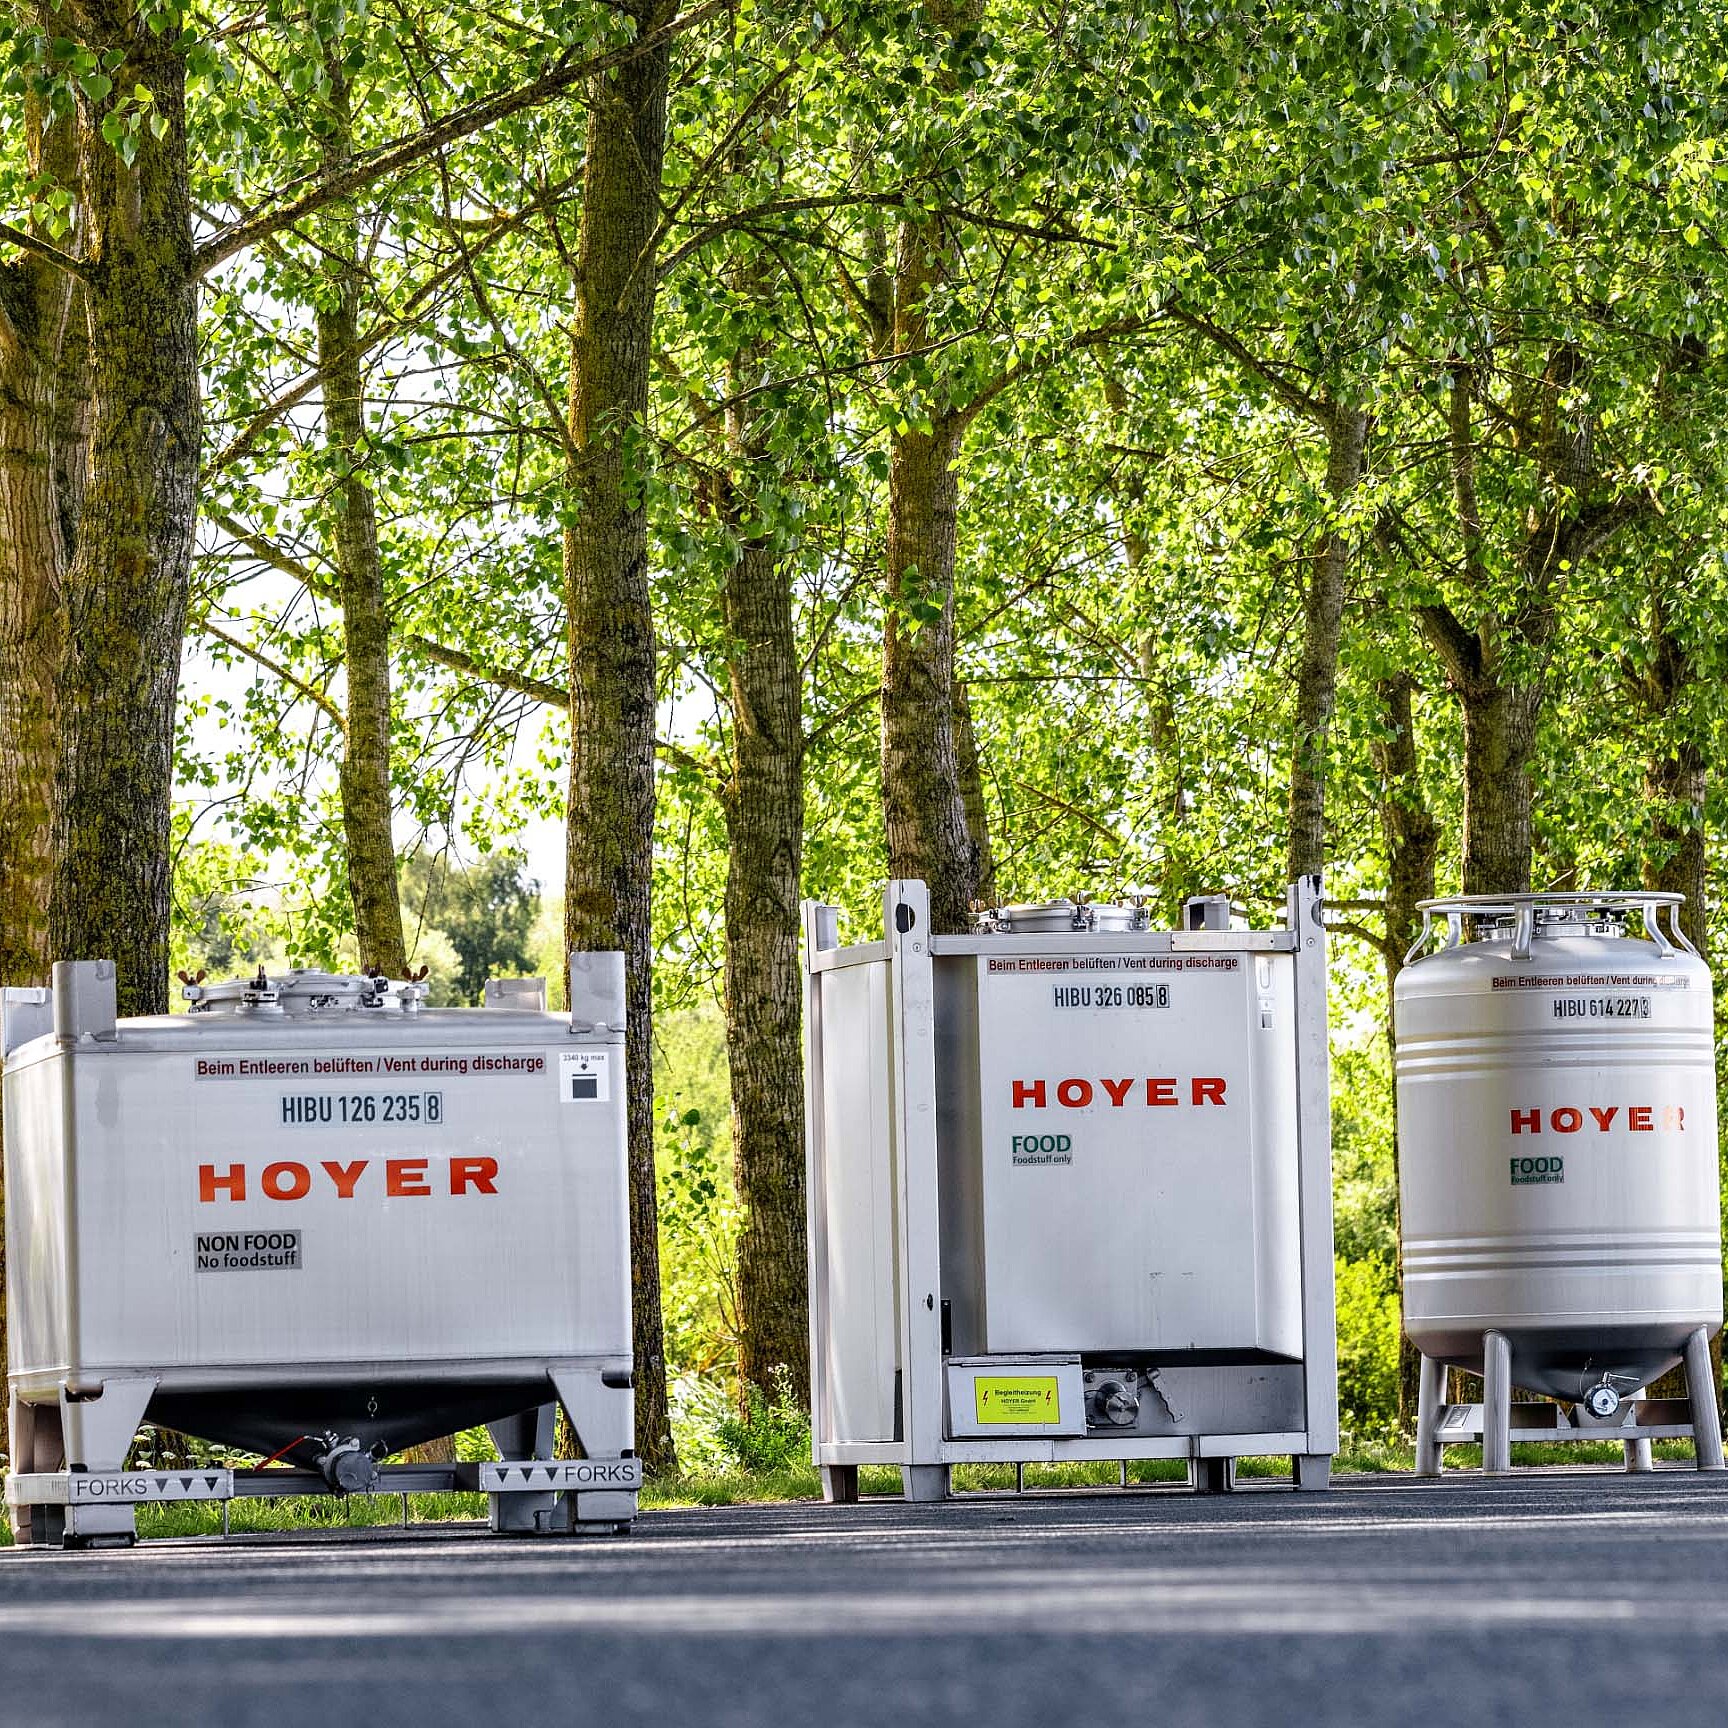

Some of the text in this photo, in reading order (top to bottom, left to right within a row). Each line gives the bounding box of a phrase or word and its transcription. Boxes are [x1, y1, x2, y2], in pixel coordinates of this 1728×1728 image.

[989, 960, 1016, 971] Beim
[1019, 959, 1069, 970] Entleeren
[1072, 958, 1116, 969] belüften
[1123, 957, 1147, 968] Vent
[1149, 957, 1183, 970] during
[1186, 956, 1238, 970] discharge
[1492, 977, 1516, 988] Beim
[1518, 976, 1564, 987] Entleeren
[1566, 975, 1605, 985] belüften
[1611, 976, 1631, 985] Vent
[1055, 987, 1091, 1007] HIBU
[1095, 987, 1122, 1007] 326
[1127, 986, 1154, 1006] 085
[1554, 999, 1586, 1017] HIBU
[1590, 999, 1614, 1016] 614
[1617, 999, 1638, 1016] 227
[197, 1060, 235, 1075] Beim
[239, 1059, 309, 1074] Entleeren
[314, 1058, 373, 1073] belüften
[384, 1057, 416, 1072] Vent
[421, 1057, 468, 1074] during
[472, 1055, 544, 1072] discharge
[1012, 1077, 1227, 1108] HOYER
[282, 1096, 332, 1123] HIBU
[338, 1096, 376, 1122] 126
[383, 1095, 420, 1121] 235
[1510, 1106, 1685, 1134] HOYER
[1012, 1135, 1072, 1153] FOOD
[1012, 1155, 1072, 1166] Foodstuff only
[1510, 1156, 1563, 1175] FOOD
[198, 1156, 499, 1202] HOYER
[197, 1233, 297, 1253] NON FOOD
[198, 1251, 297, 1269] No foodstuff
[565, 1465, 635, 1482] FORKS
[76, 1477, 147, 1496] FORKS
